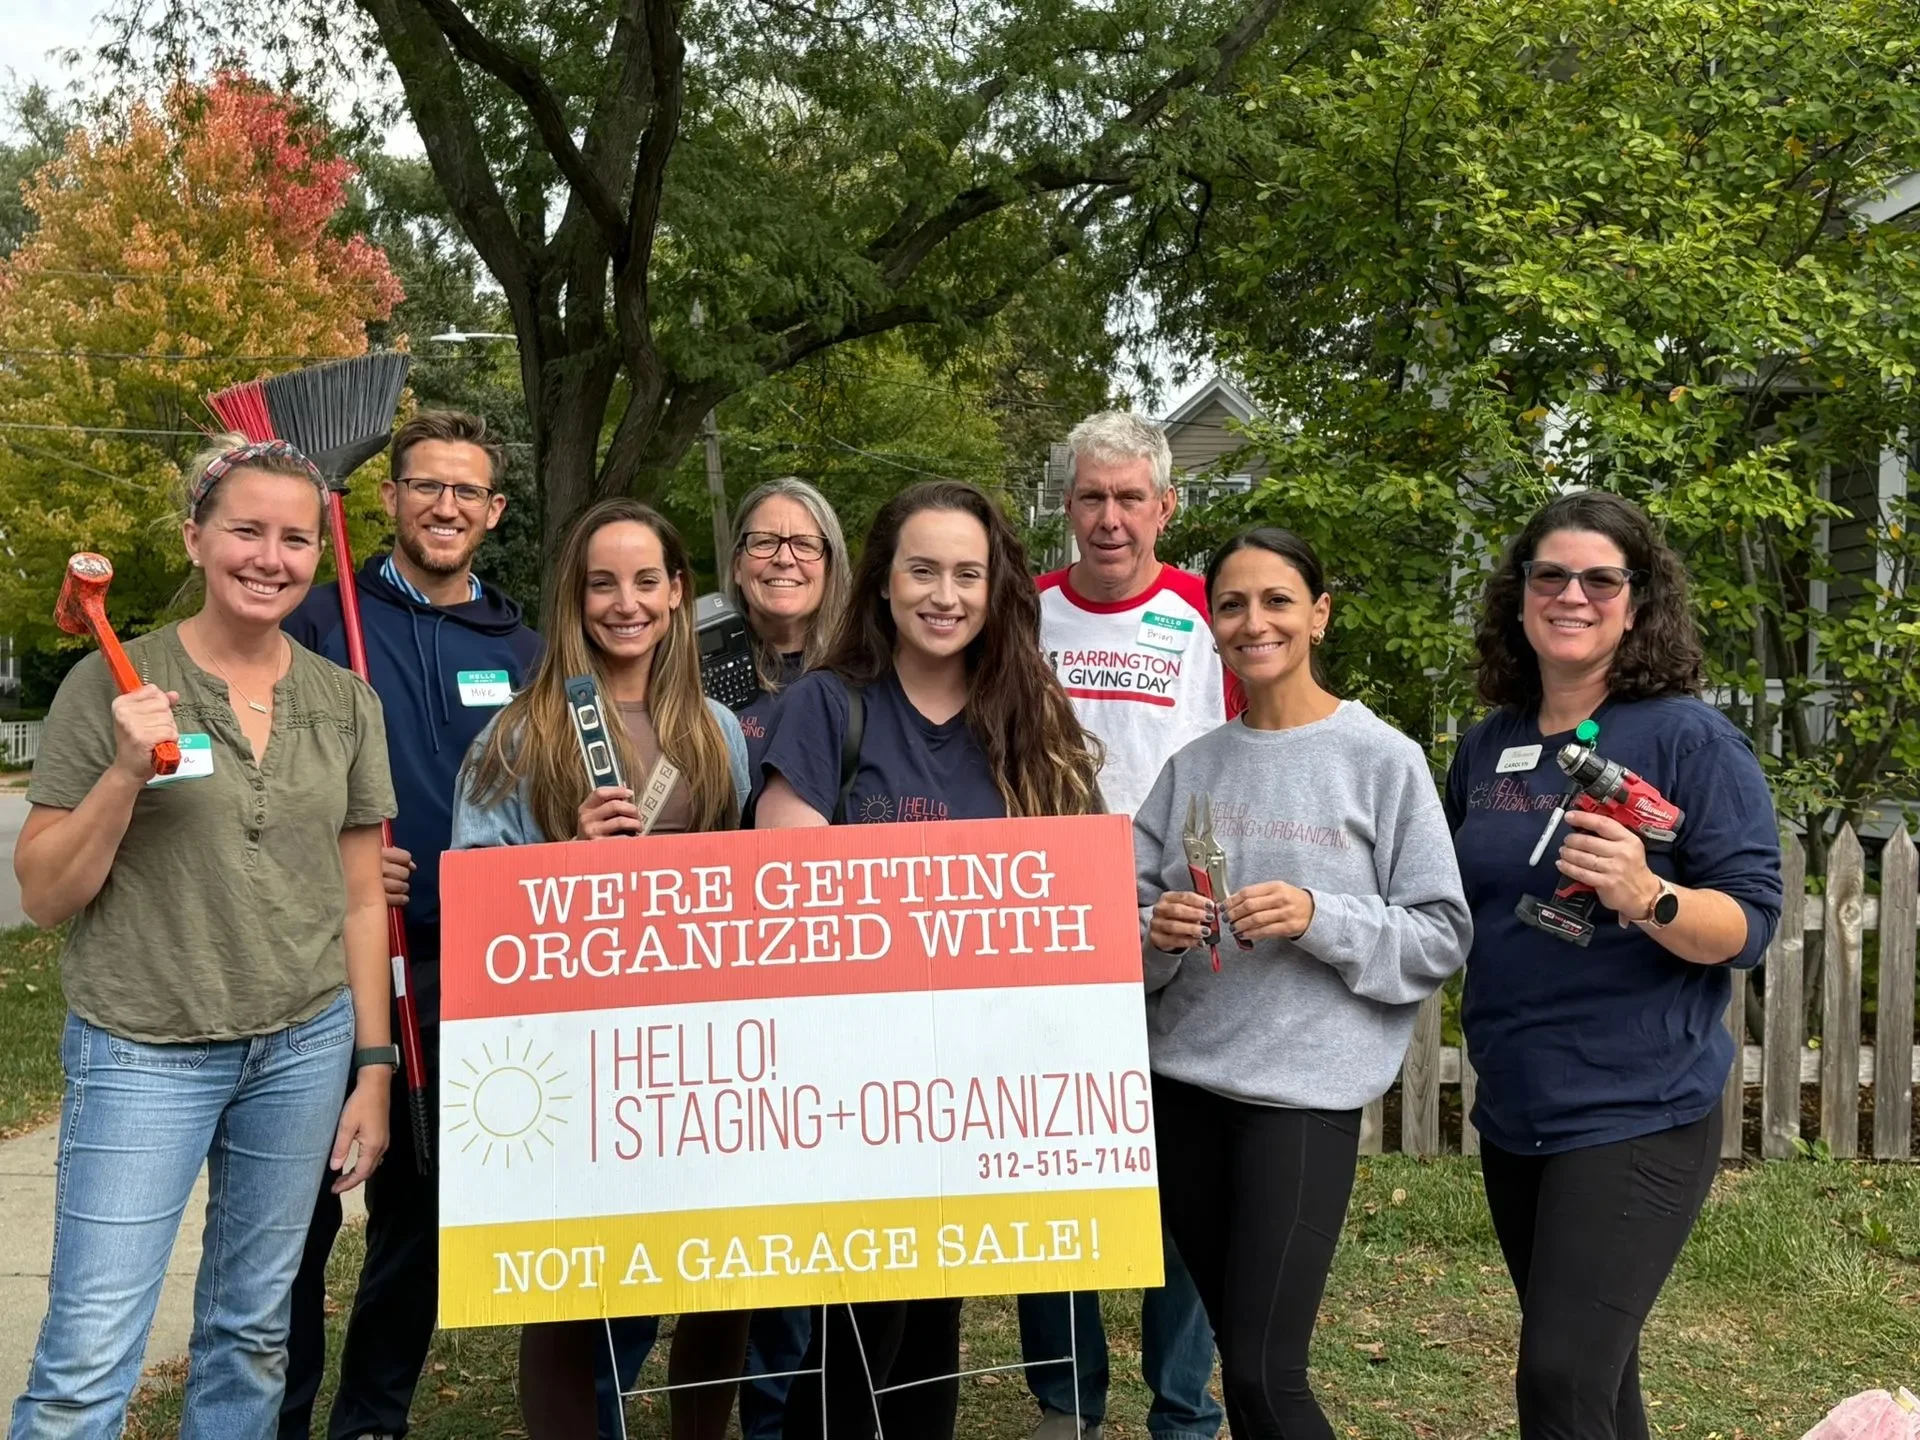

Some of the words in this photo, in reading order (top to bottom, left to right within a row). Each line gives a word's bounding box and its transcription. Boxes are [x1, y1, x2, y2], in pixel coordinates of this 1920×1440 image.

[1154, 615, 1182, 626] HELLO
[1147, 628, 1174, 644] Brian
[468, 672, 496, 680] HELLO
[1063, 650, 1181, 677] BARRINGTON
[1068, 668, 1132, 688] GIVING
[1136, 673, 1171, 693] DAY
[1634, 797, 1674, 821] Milwaukee
[518, 865, 733, 926] WE'RE
[753, 850, 1056, 911] GETTING
[484, 912, 893, 985] ORGANIZED
[908, 904, 1097, 959] WITH
[613, 1018, 779, 1091] HELLO!
[613, 1069, 1151, 1161] STAGING+ORGANIZING
[977, 1146, 1152, 1180] 312-515-7140
[492, 1245, 606, 1294] NOT
[619, 1242, 663, 1286] A
[676, 1227, 919, 1281] GARAGE
[936, 1218, 1100, 1268] SALE!
